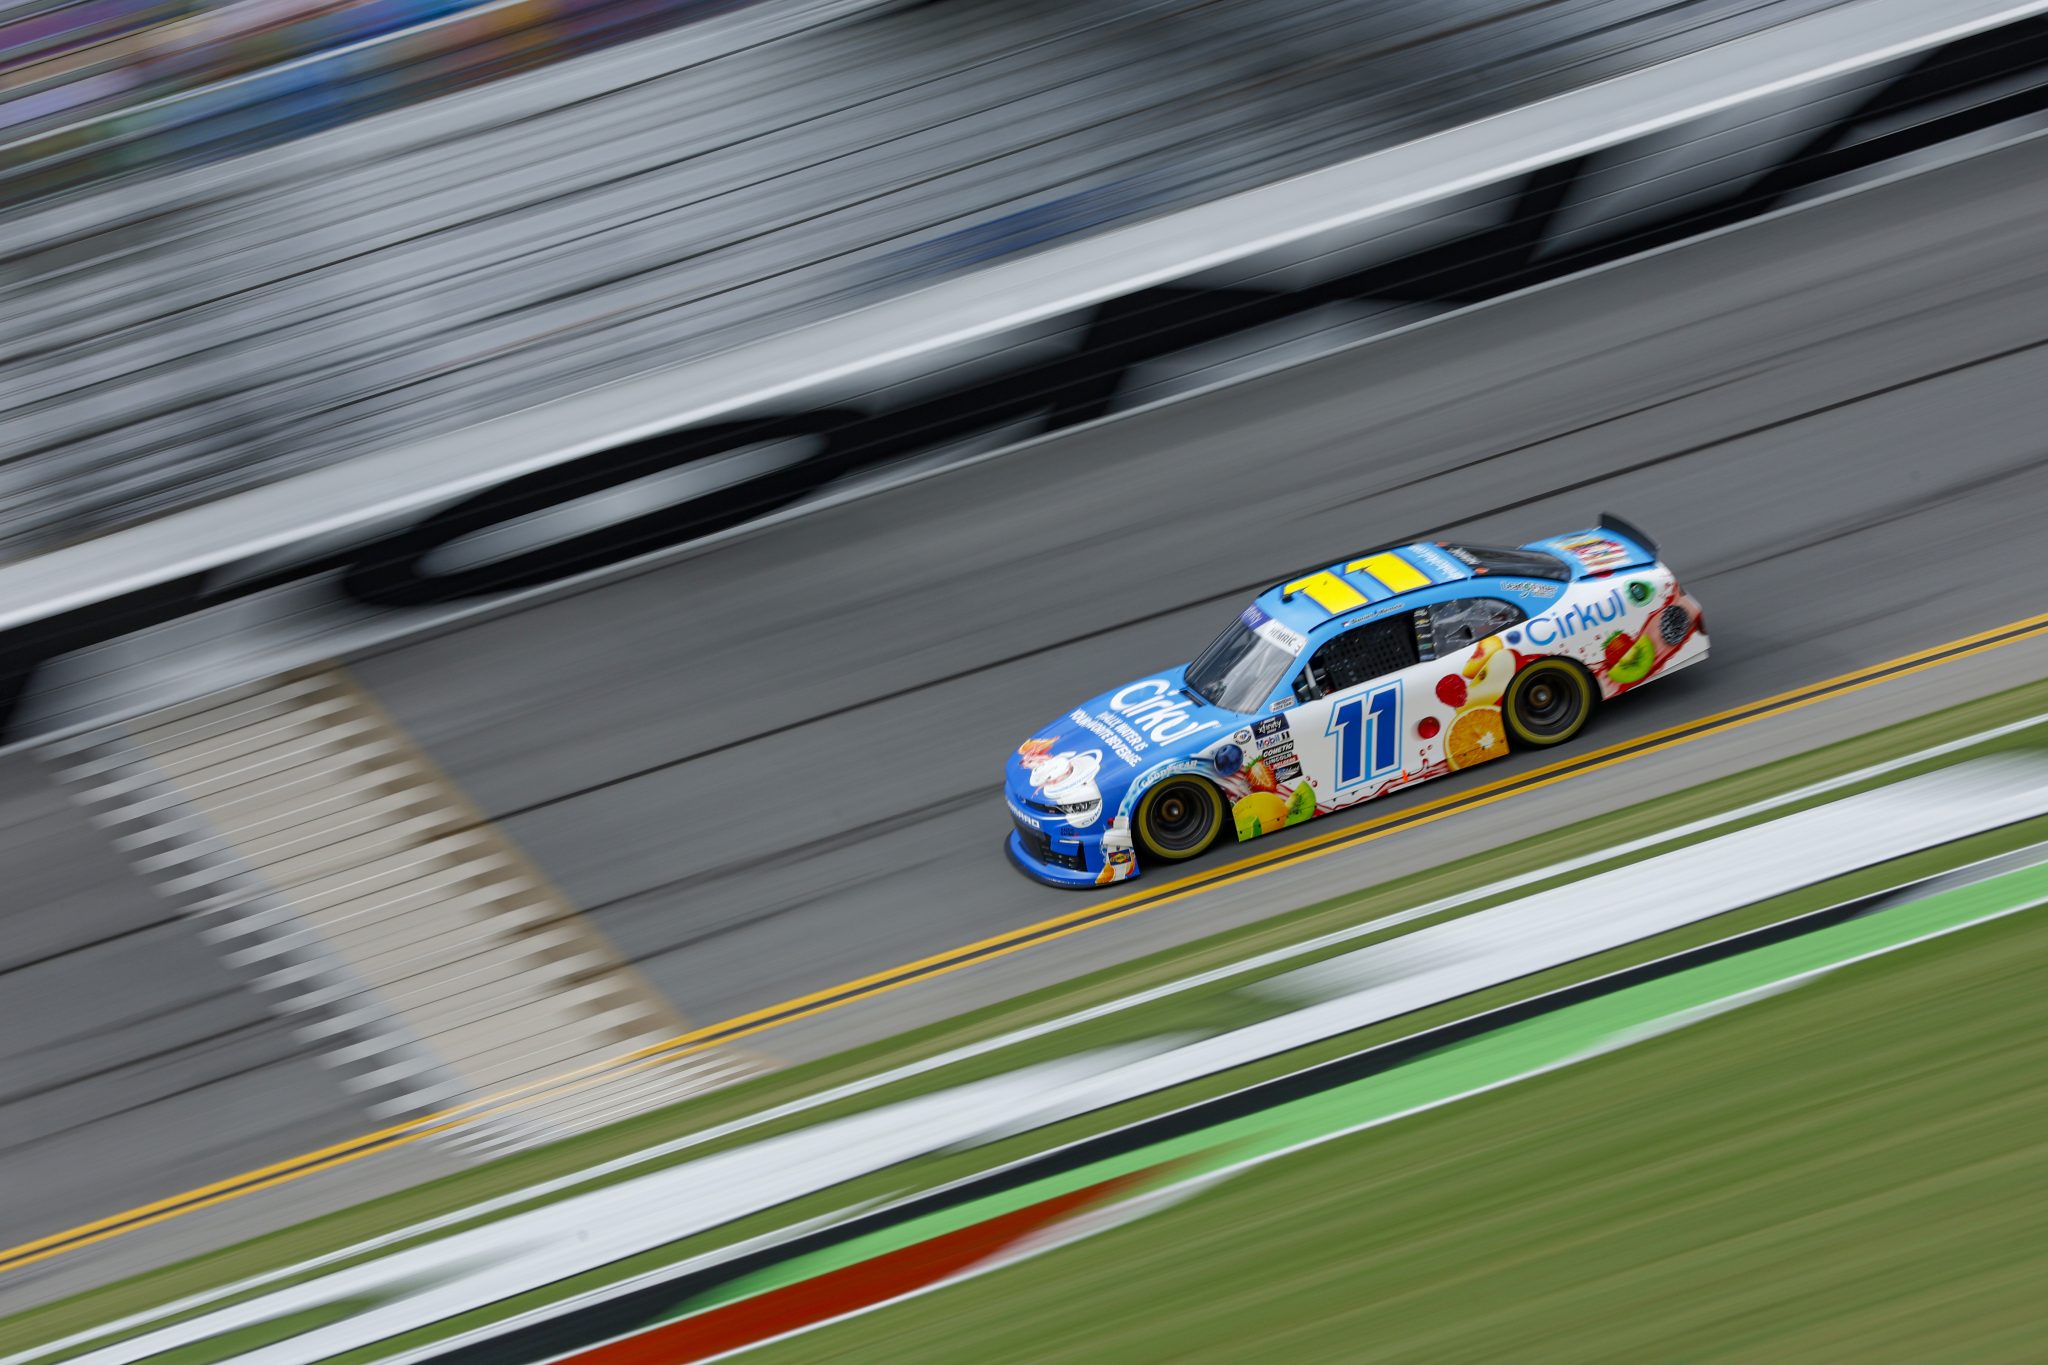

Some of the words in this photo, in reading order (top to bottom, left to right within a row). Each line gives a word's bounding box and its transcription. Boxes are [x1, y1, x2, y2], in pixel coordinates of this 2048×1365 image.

[1283, 552, 1433, 615] 11
[1525, 588, 1626, 646] Cirkul
[1110, 679, 1219, 747] Cirkul
[1256, 734, 1280, 750] Mobil
[1327, 681, 1401, 790] 11
